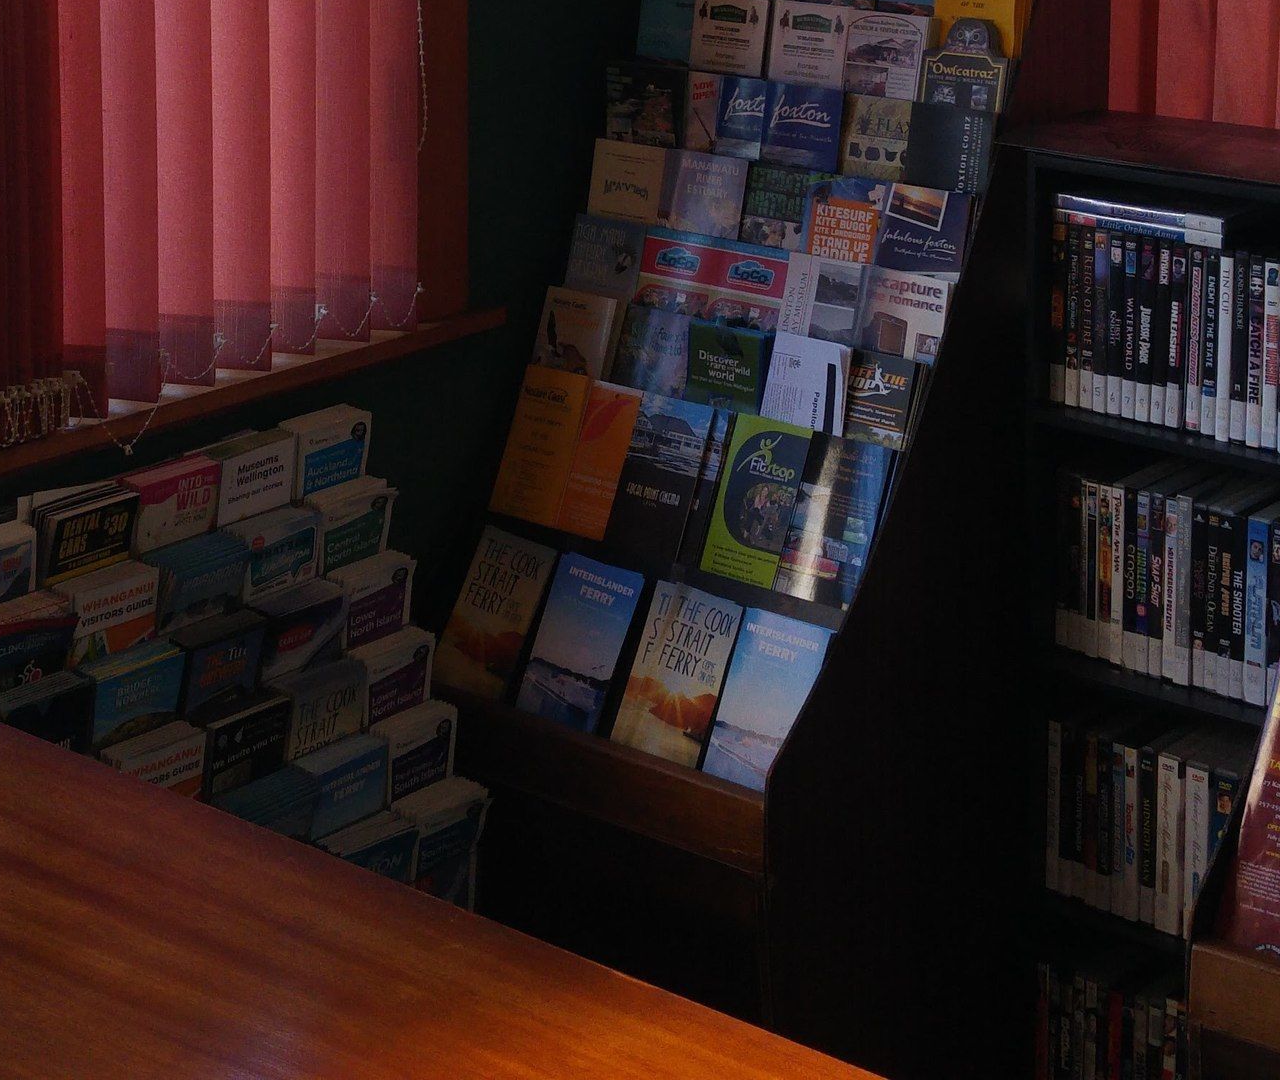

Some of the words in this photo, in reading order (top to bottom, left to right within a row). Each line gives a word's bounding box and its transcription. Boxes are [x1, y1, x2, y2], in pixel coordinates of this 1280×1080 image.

[815, 216, 837, 228] KITE
[839, 219, 872, 234] BUGGY
[816, 204, 875, 224] KITESURF
[1101, 219, 1122, 232] Little
[1122, 223, 1152, 237] Orphan
[1153, 228, 1179, 241] Annie
[813, 235, 850, 251] STAND
[853, 241, 870, 254] UP
[1083, 255, 1095, 296] REIGN
[1222, 268, 1230, 290] TIN
[880, 278, 943, 303] capture
[1207, 275, 1217, 308] ENEMY
[888, 294, 944, 314] romance
[1084, 298, 1094, 312] OF
[1206, 310, 1216, 322] OF
[1220, 292, 1229, 316] CUP
[1081, 315, 1093, 345] FIRE
[1124, 296, 1137, 371] WATERWORLD
[1139, 304, 1154, 342] JURASSIC
[1168, 301, 1180, 368] UNLEASHED
[1205, 324, 1215, 340] THE
[699, 349, 740, 367] Discover
[1138, 342, 1150, 365] PARK
[1204, 341, 1214, 369] STATE
[708, 366, 736, 382] world
[236, 455, 280, 474] Museums
[236, 465, 285, 488] Wellington
[483, 539, 512, 567] THE
[511, 550, 545, 581] COOK
[1150, 554, 1162, 580] SNAP
[1208, 543, 1218, 570] DEEP
[474, 560, 520, 596] STRAIT
[569, 564, 635, 599] INTERISLANDER
[1126, 543, 1136, 600] eragon
[1207, 573, 1217, 593] END
[1234, 570, 1244, 589] THE
[465, 582, 507, 615] FERRY
[579, 586, 616, 607] FERRY
[1149, 580, 1161, 608] SHOT
[81, 606, 126, 628] VISITORS
[126, 597, 155, 616] GUIDE
[677, 595, 704, 623] THE
[703, 609, 736, 639] COOK
[1206, 600, 1216, 633] OCEAN
[1232, 589, 1243, 636] SHOOTER
[665, 622, 715, 656] STRAIT
[746, 622, 820, 652] INTERISLANDER
[658, 645, 702, 679] FERRY
[758, 640, 798, 665] FERRY
